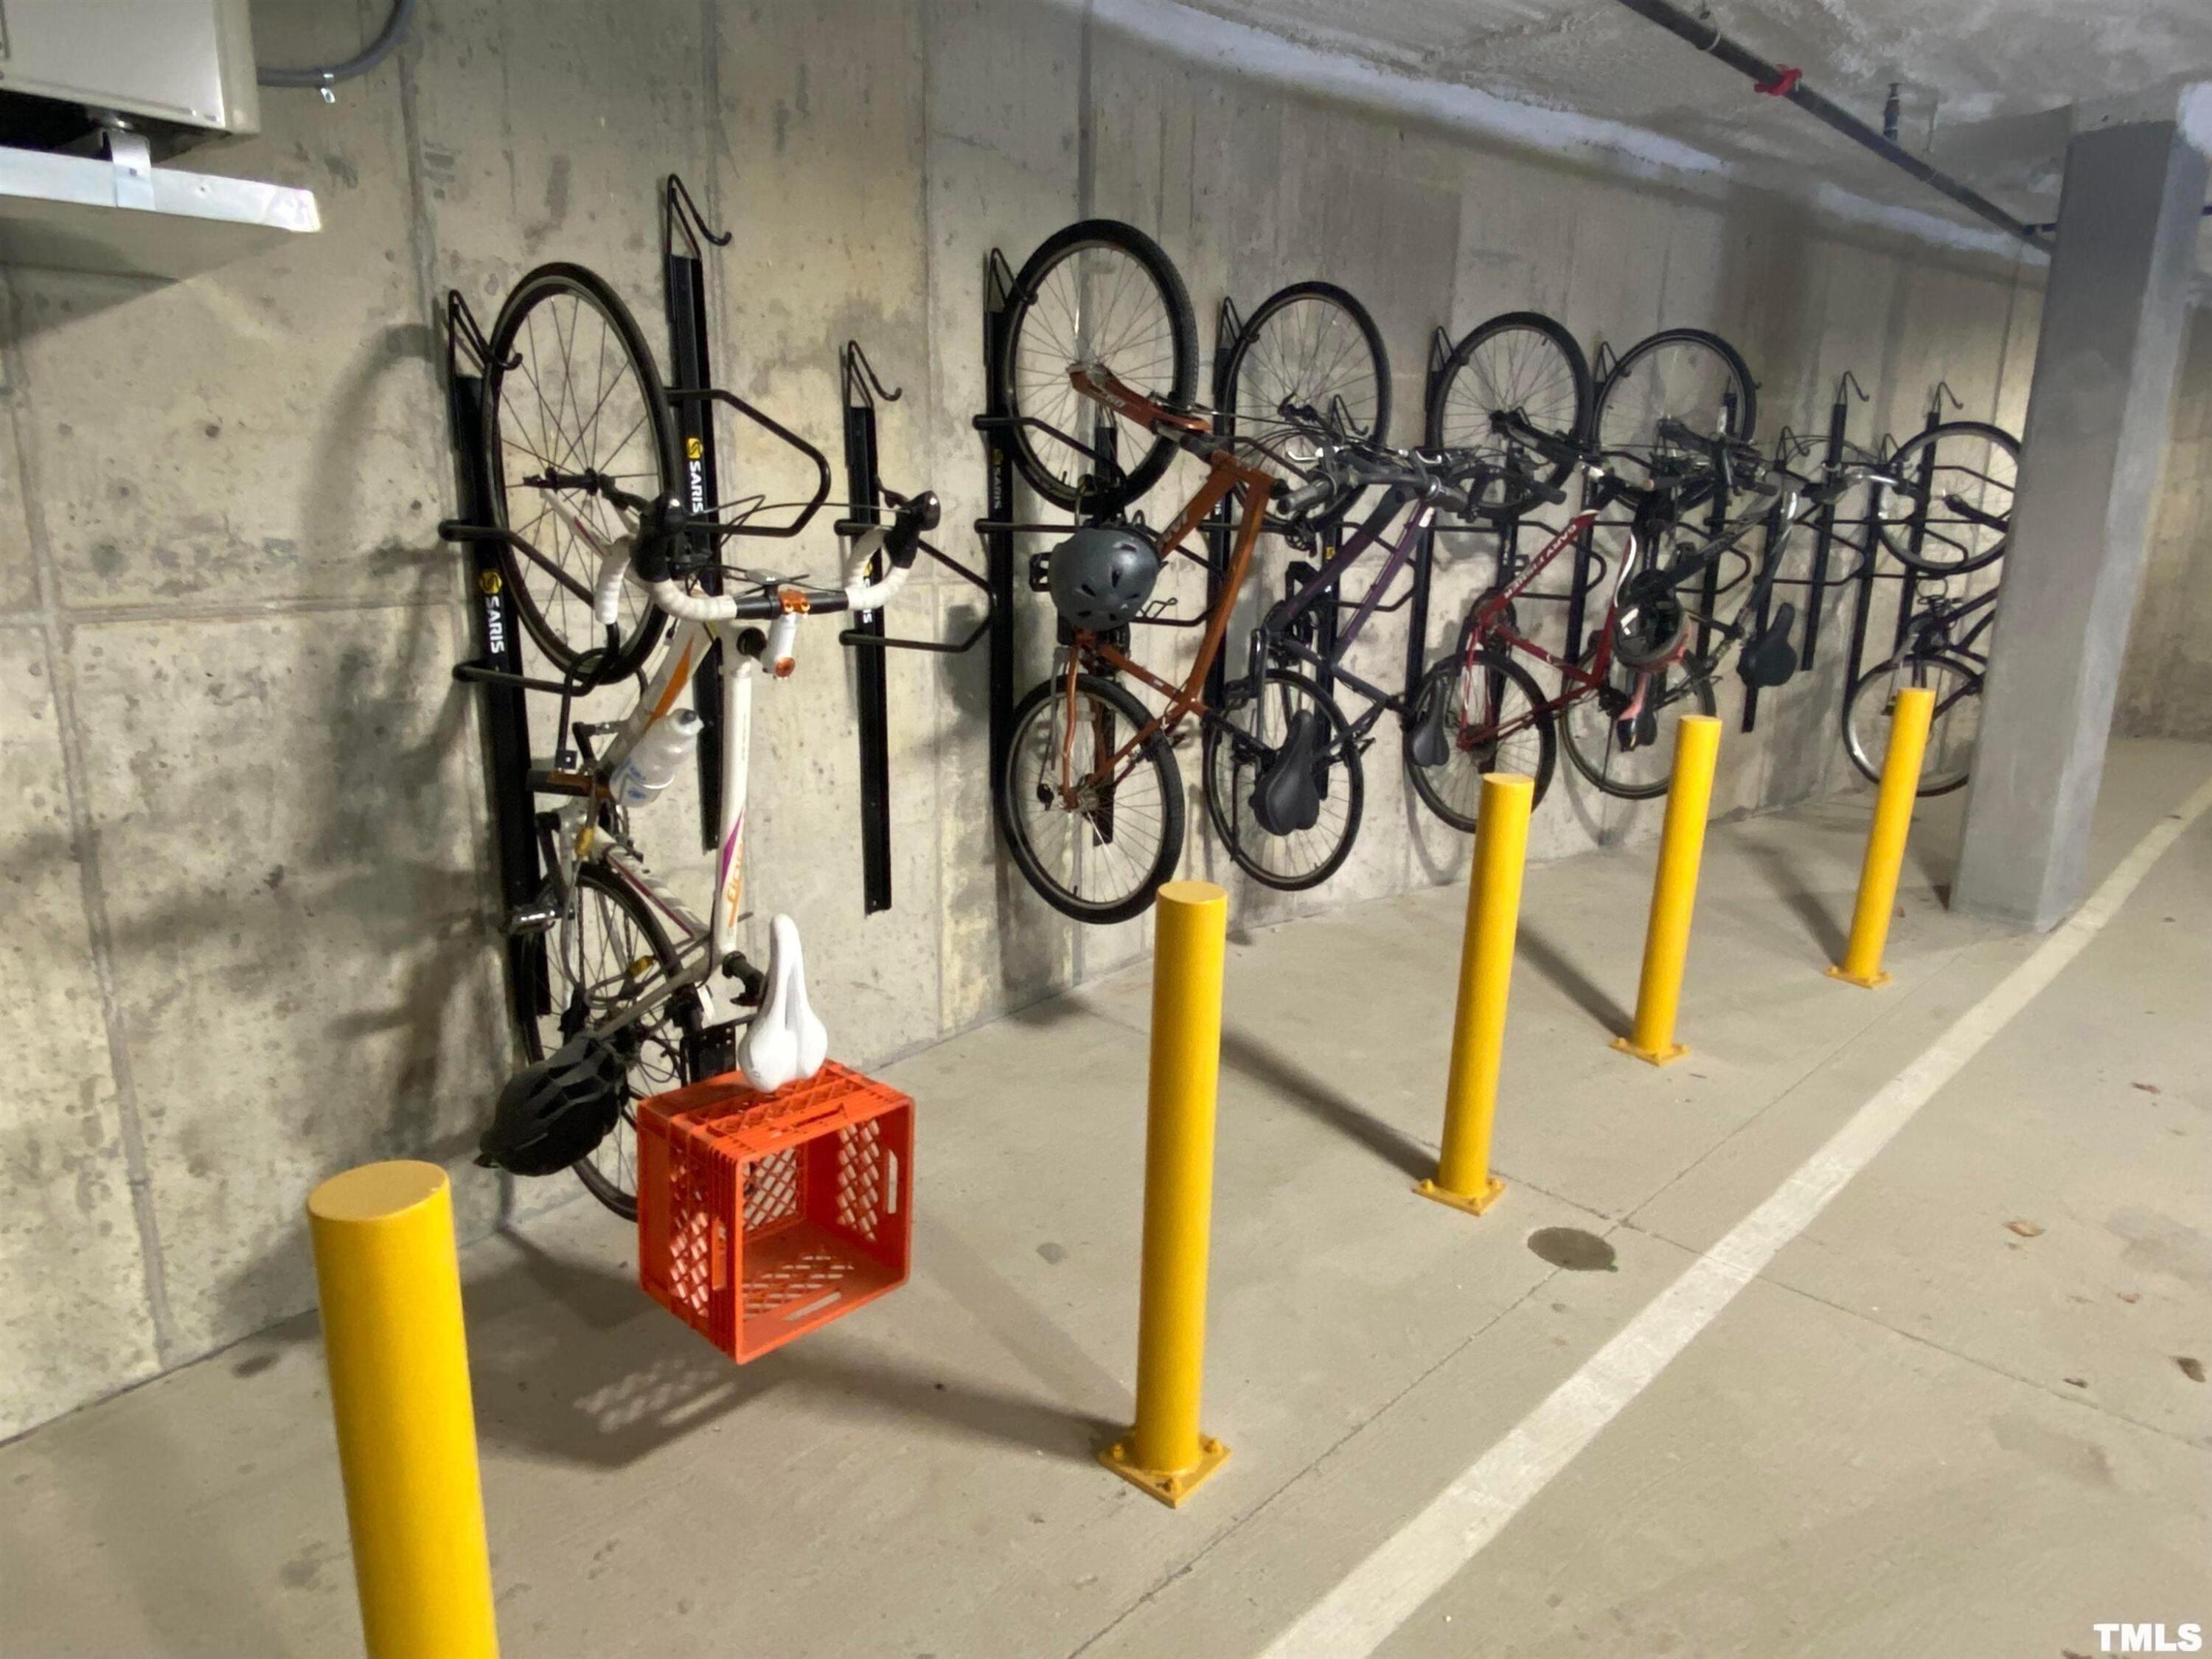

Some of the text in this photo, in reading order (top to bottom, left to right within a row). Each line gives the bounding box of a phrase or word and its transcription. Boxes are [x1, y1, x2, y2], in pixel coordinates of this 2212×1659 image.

[689, 460, 704, 513] SARIS
[992, 466, 1002, 509] SARIS
[485, 595, 505, 654] SARIS
